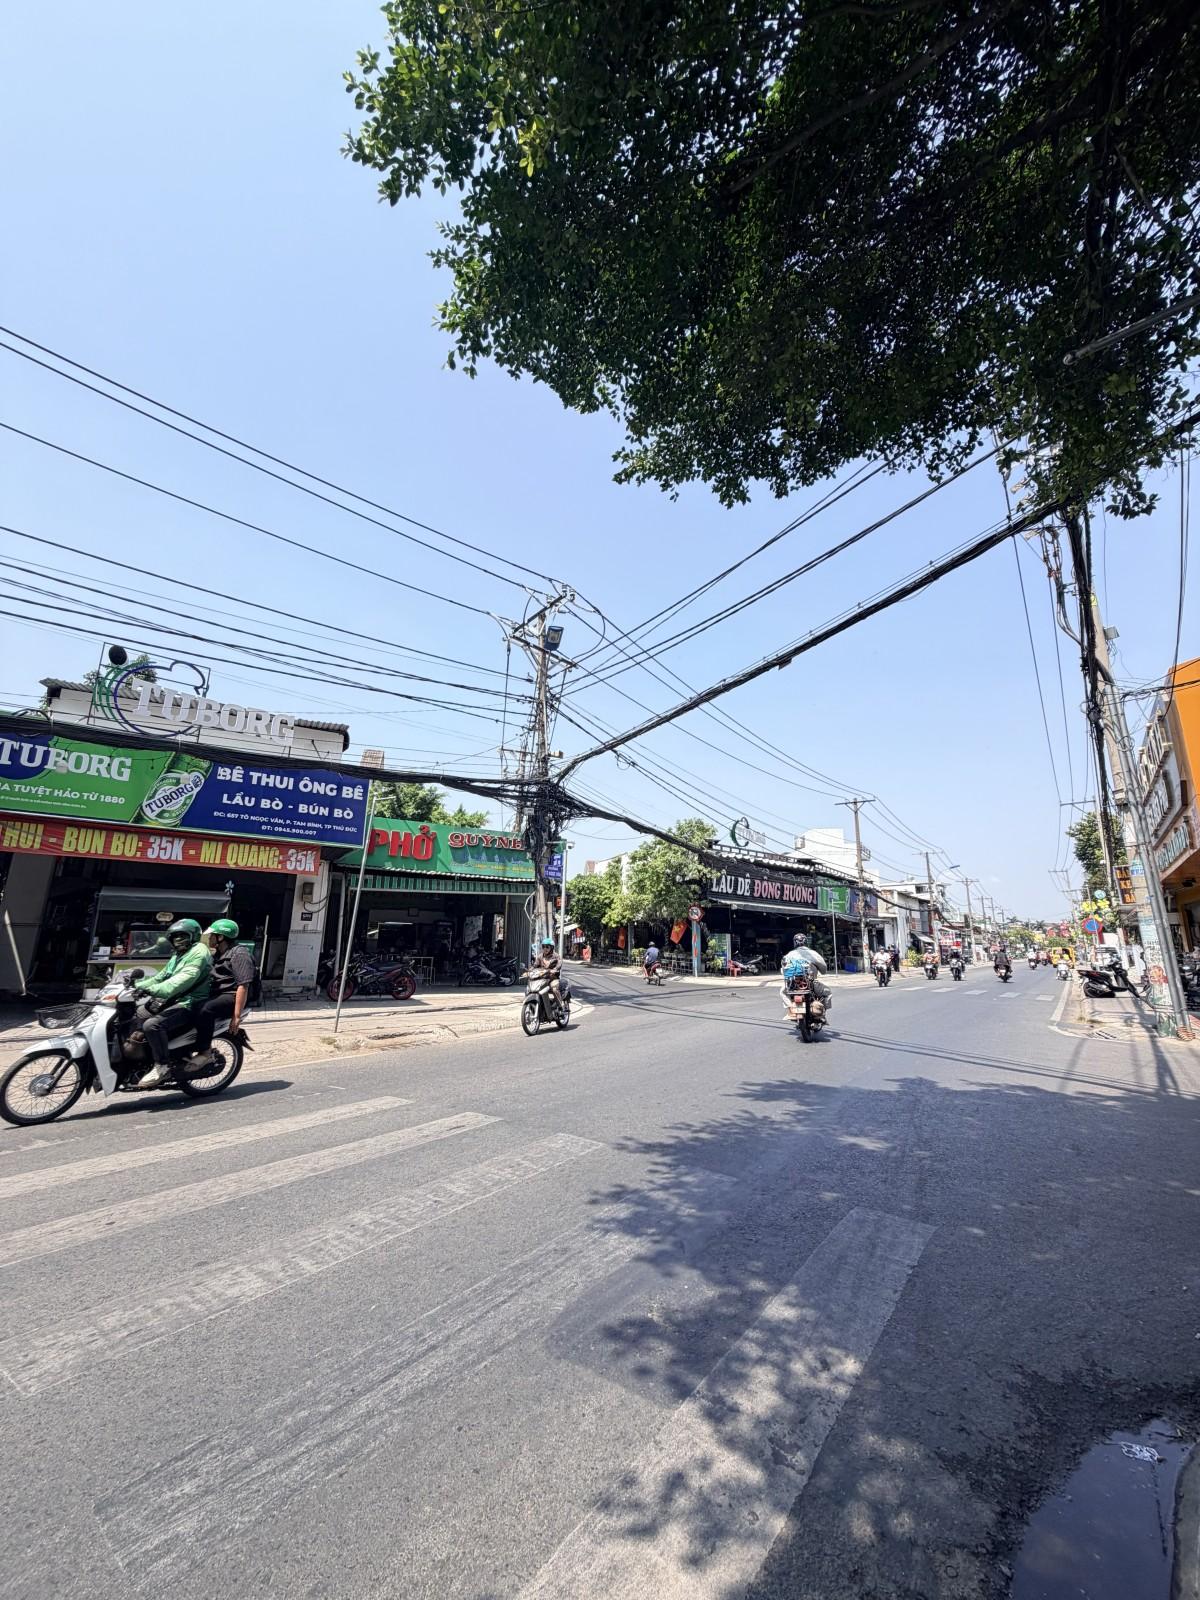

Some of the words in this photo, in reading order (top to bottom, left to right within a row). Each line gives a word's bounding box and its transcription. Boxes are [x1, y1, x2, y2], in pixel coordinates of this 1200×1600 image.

[131, 677, 296, 746] TUBORG
[14, 784, 52, 798] TUYỆT
[53, 788, 80, 799] HẢO
[82, 791, 99, 801] TỪ
[100, 795, 125, 804] 1880
[145, 783, 194, 814] TUBORG
[217, 766, 245, 783] BÊ
[249, 771, 294, 790] THUI
[299, 776, 338, 796] ÔNG
[341, 785, 364, 800] BÊ
[260, 797, 283, 810] BÒ
[298, 802, 329, 817] BÚN
[333, 807, 354, 820] BÒ
[146, 835, 186, 861] 35K
[286, 848, 317, 872] 35K
[368, 824, 437, 861] PHỞ
[736, 873, 751, 896] DÊ
